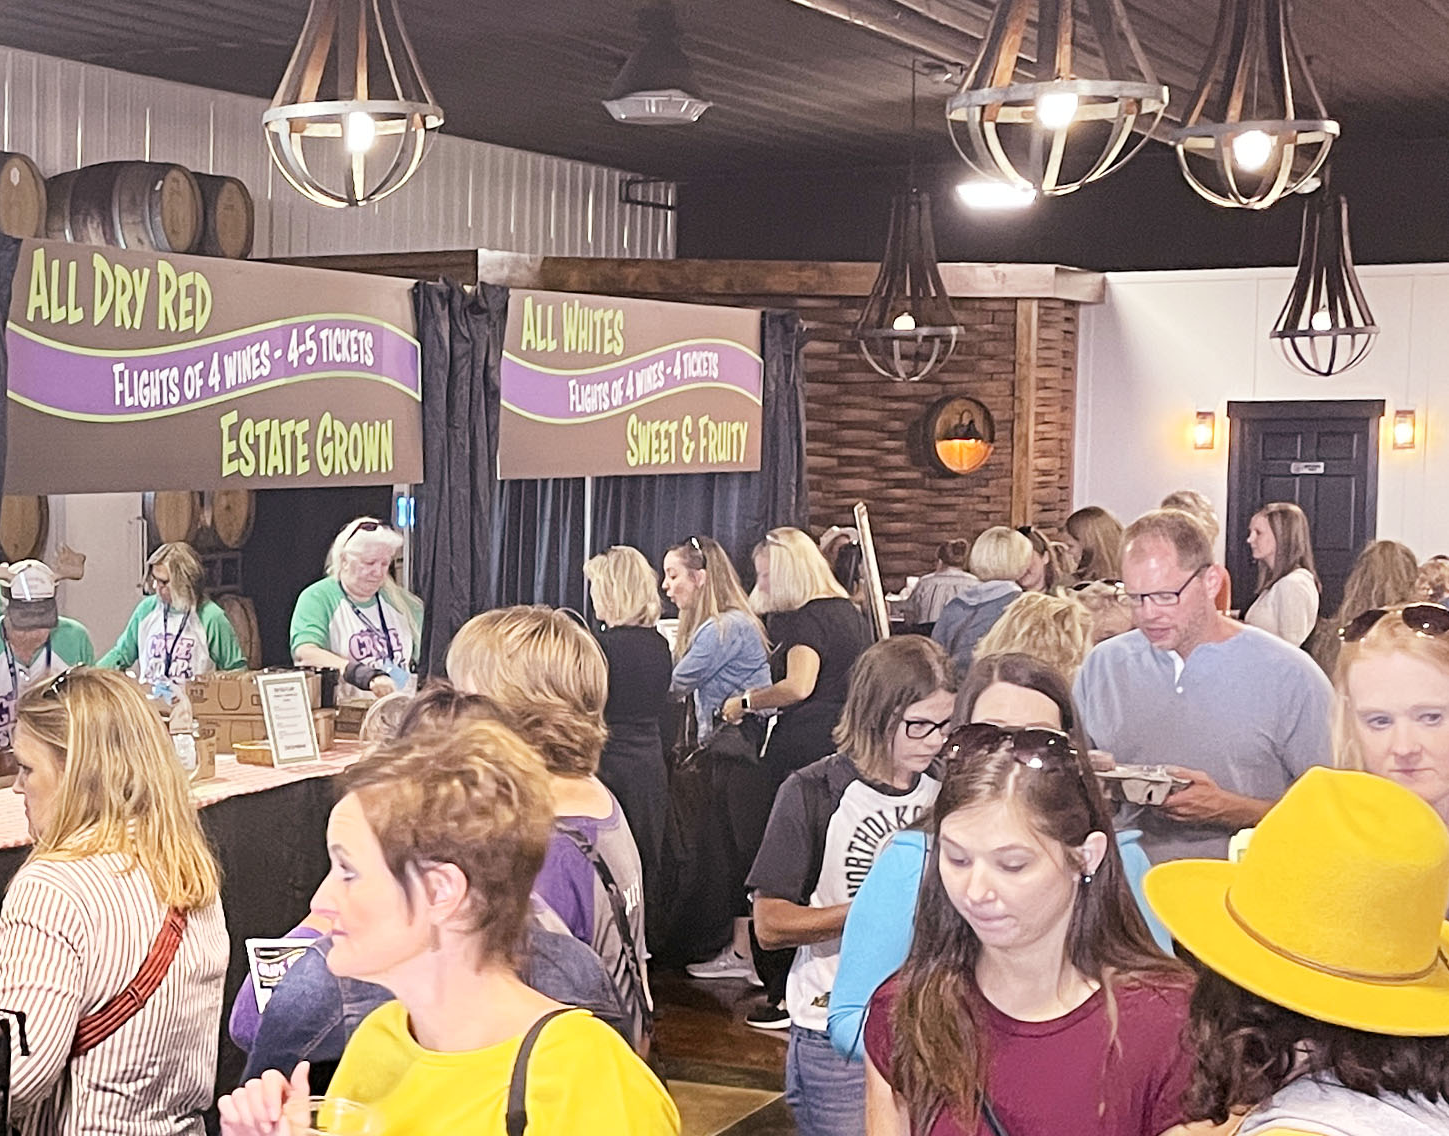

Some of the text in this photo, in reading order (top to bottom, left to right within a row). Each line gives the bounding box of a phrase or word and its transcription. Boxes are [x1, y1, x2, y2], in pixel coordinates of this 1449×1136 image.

[26, 249, 211, 335] ALL DRY RED
[520, 295, 625, 356] ALL WHITES
[112, 361, 181, 409] FLIGHTS
[182, 359, 206, 401] OF
[207, 350, 221, 393] 4
[223, 339, 272, 390] WINES
[286, 323, 318, 369] 4-5
[318, 325, 375, 368] TICKETS
[567, 377, 611, 414] FLIGHTS
[610, 374, 626, 408] OF
[624, 368, 635, 402] 4
[635, 359, 666, 399] WINES
[673, 350, 682, 381] 4
[682, 350, 720, 380] TICKETS
[220, 410, 394, 477] ESTATE GROWN
[626, 413, 749, 467] SWEET & FRUITY
